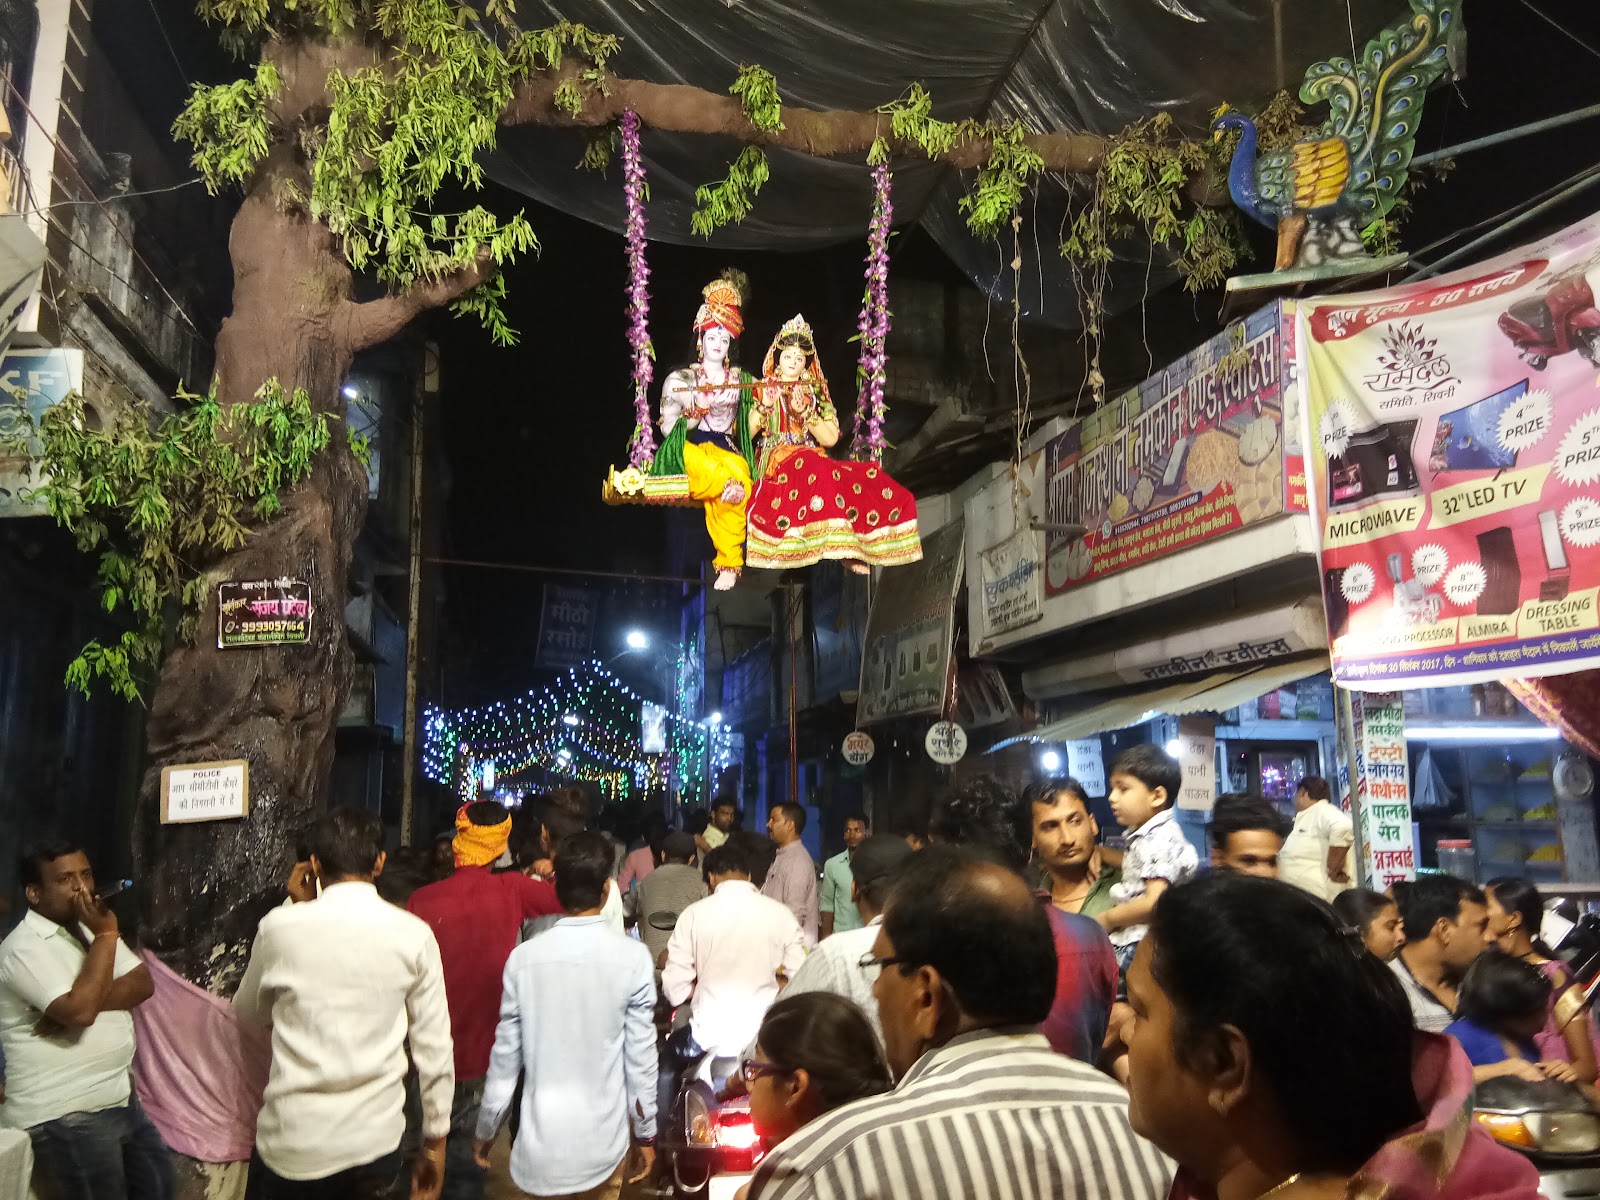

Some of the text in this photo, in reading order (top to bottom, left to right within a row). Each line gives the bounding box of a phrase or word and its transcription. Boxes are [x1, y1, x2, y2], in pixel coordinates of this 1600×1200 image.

[1364, 300, 1415, 325] मूल्य
[1430, 290, 1466, 306] 50
[1363, 354, 1451, 390] रामदल
[1423, 386, 1455, 403] सिवनी
[1134, 371, 1182, 472] नमकीन
[1505, 419, 1545, 440] PRIZE
[1564, 446, 1600, 468] PRIZ
[1500, 478, 1528, 499] TV
[1329, 506, 1417, 540] MICROWAVE
[1569, 518, 1600, 534] PRIZE
[1416, 563, 1441, 575] PRIZE
[1345, 583, 1369, 595] PRIZE
[1450, 581, 1480, 594] PRIZE
[251, 596, 280, 617] संजय
[281, 595, 307, 617] पटेल
[1526, 598, 1591, 620] DRESSING
[242, 621, 304, 633] 9993057664
[1467, 621, 1509, 639] ALMIRA
[1538, 615, 1580, 633] TABLE
[1404, 628, 1455, 644] PROCESSOR
[1140, 656, 1208, 680] नमकीन
[1388, 660, 1398, 674] 30
[1367, 722, 1403, 738] नमकीन
[1368, 741, 1403, 761] टेस्टी
[193, 770, 221, 779] POLICE
[1077, 762, 1095, 772] पानी
[1187, 765, 1206, 777] पानी
[1372, 803, 1409, 820] पालक
[1378, 820, 1400, 842] सेव
